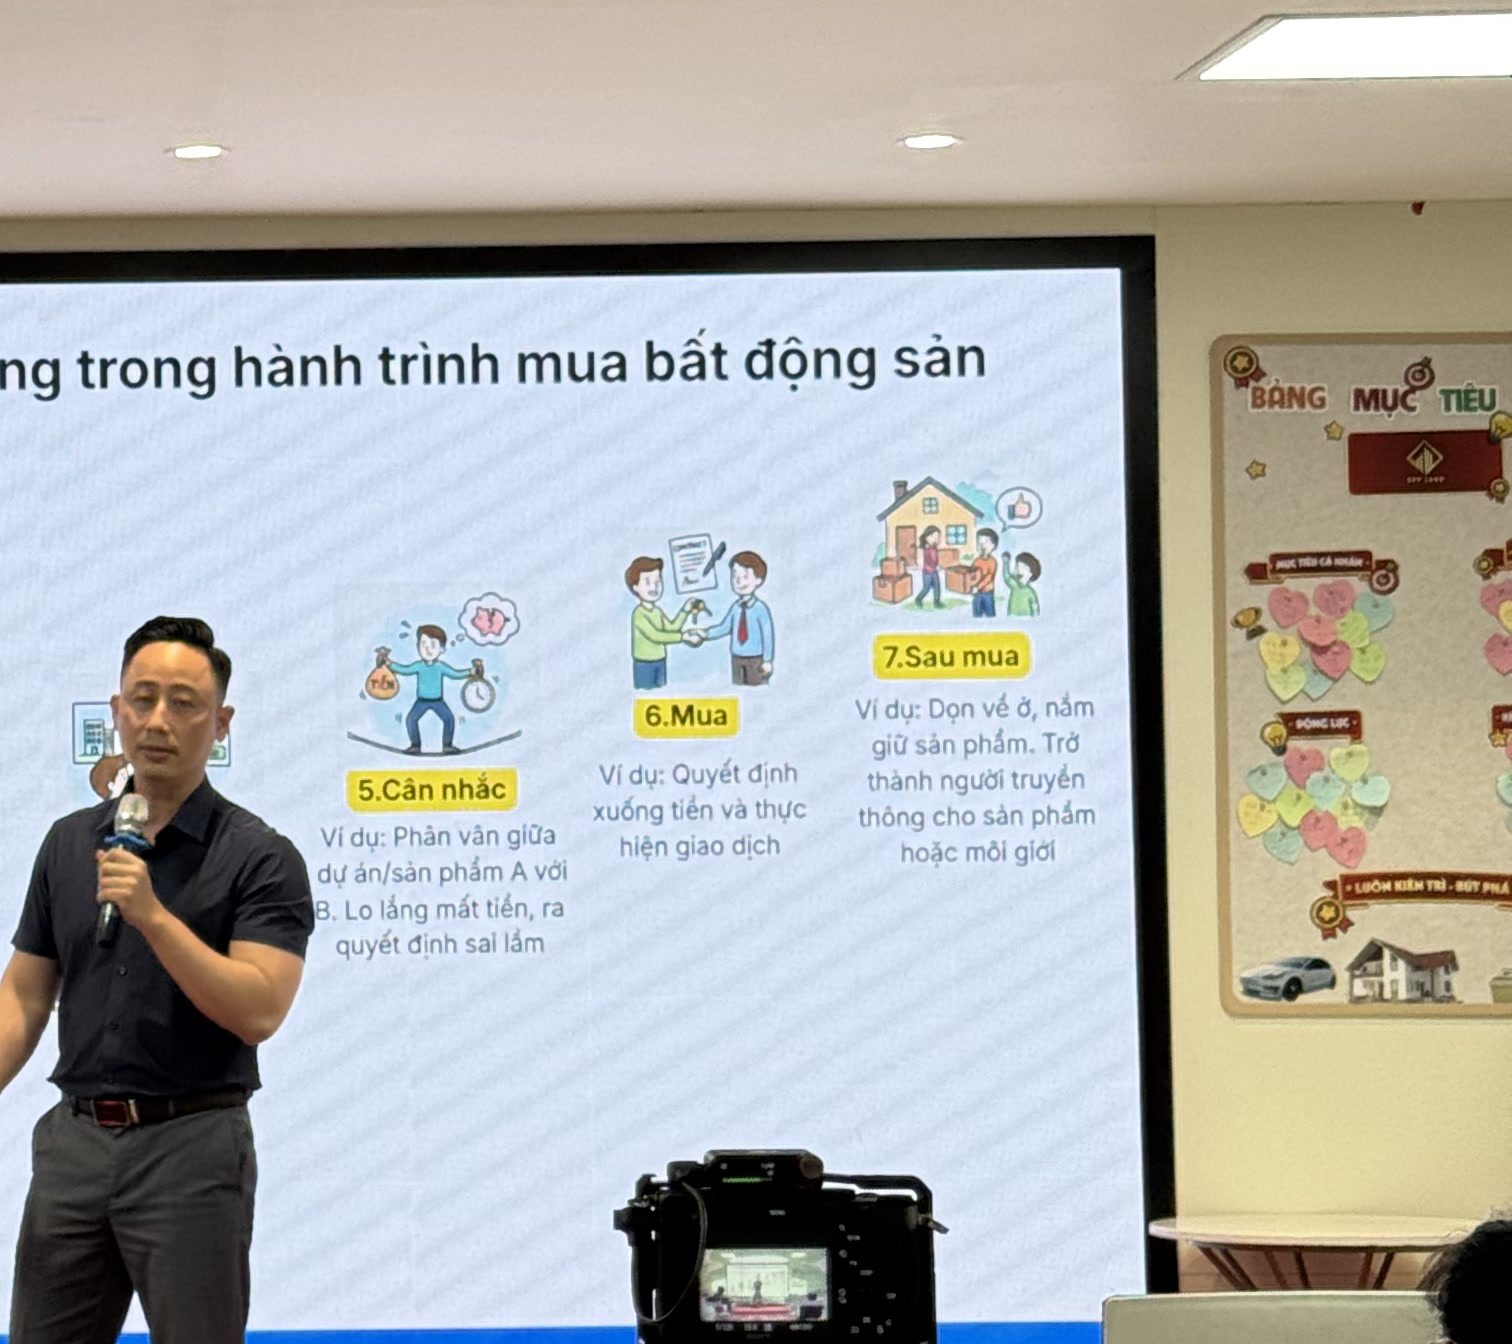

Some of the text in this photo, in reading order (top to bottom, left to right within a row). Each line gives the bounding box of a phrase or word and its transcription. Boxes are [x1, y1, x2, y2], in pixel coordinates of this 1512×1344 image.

[76, 350, 217, 400] trong
[233, 342, 362, 388] hành
[377, 340, 500, 386] trình
[517, 349, 628, 385] mua
[645, 327, 729, 382] bất
[744, 336, 877, 392] động
[893, 333, 986, 379] sản
[1250, 378, 1497, 419] BẢNG MỤC TIÊU
[882, 644, 1020, 669] 7.Sau mua
[645, 704, 728, 728] 6.Mua
[854, 696, 878, 720] Ví
[884, 698, 921, 726] dụ:
[928, 697, 975, 726] Dọn
[1016, 695, 1038, 723] ở,
[871, 727, 1080, 761] giữ sản phẩm. Trở
[358, 771, 506, 802] 5.Cân nhắc
[598, 757, 798, 791] Ví dụ: Quyết định
[867, 768, 933, 793] thành
[940, 768, 1005, 796] người
[592, 795, 664, 827] xuống
[720, 797, 748, 820] và
[754, 798, 808, 825] thực
[858, 799, 1096, 833] thông cho sản phẩm
[320, 823, 556, 853] Ví dụ: Phân vân giữa
[620, 833, 781, 862] hiện giao dịch
[900, 838, 1056, 868] hoặc môi giới
[317, 863, 348, 890] dự
[439, 855, 503, 887] phẩm
[510, 860, 528, 882] A
[534, 858, 568, 881] với
[315, 900, 338, 921] B.
[345, 900, 373, 921] Lo
[437, 893, 480, 920] mất
[542, 902, 565, 918] ra
[335, 927, 546, 961] quyết định sai lầm
